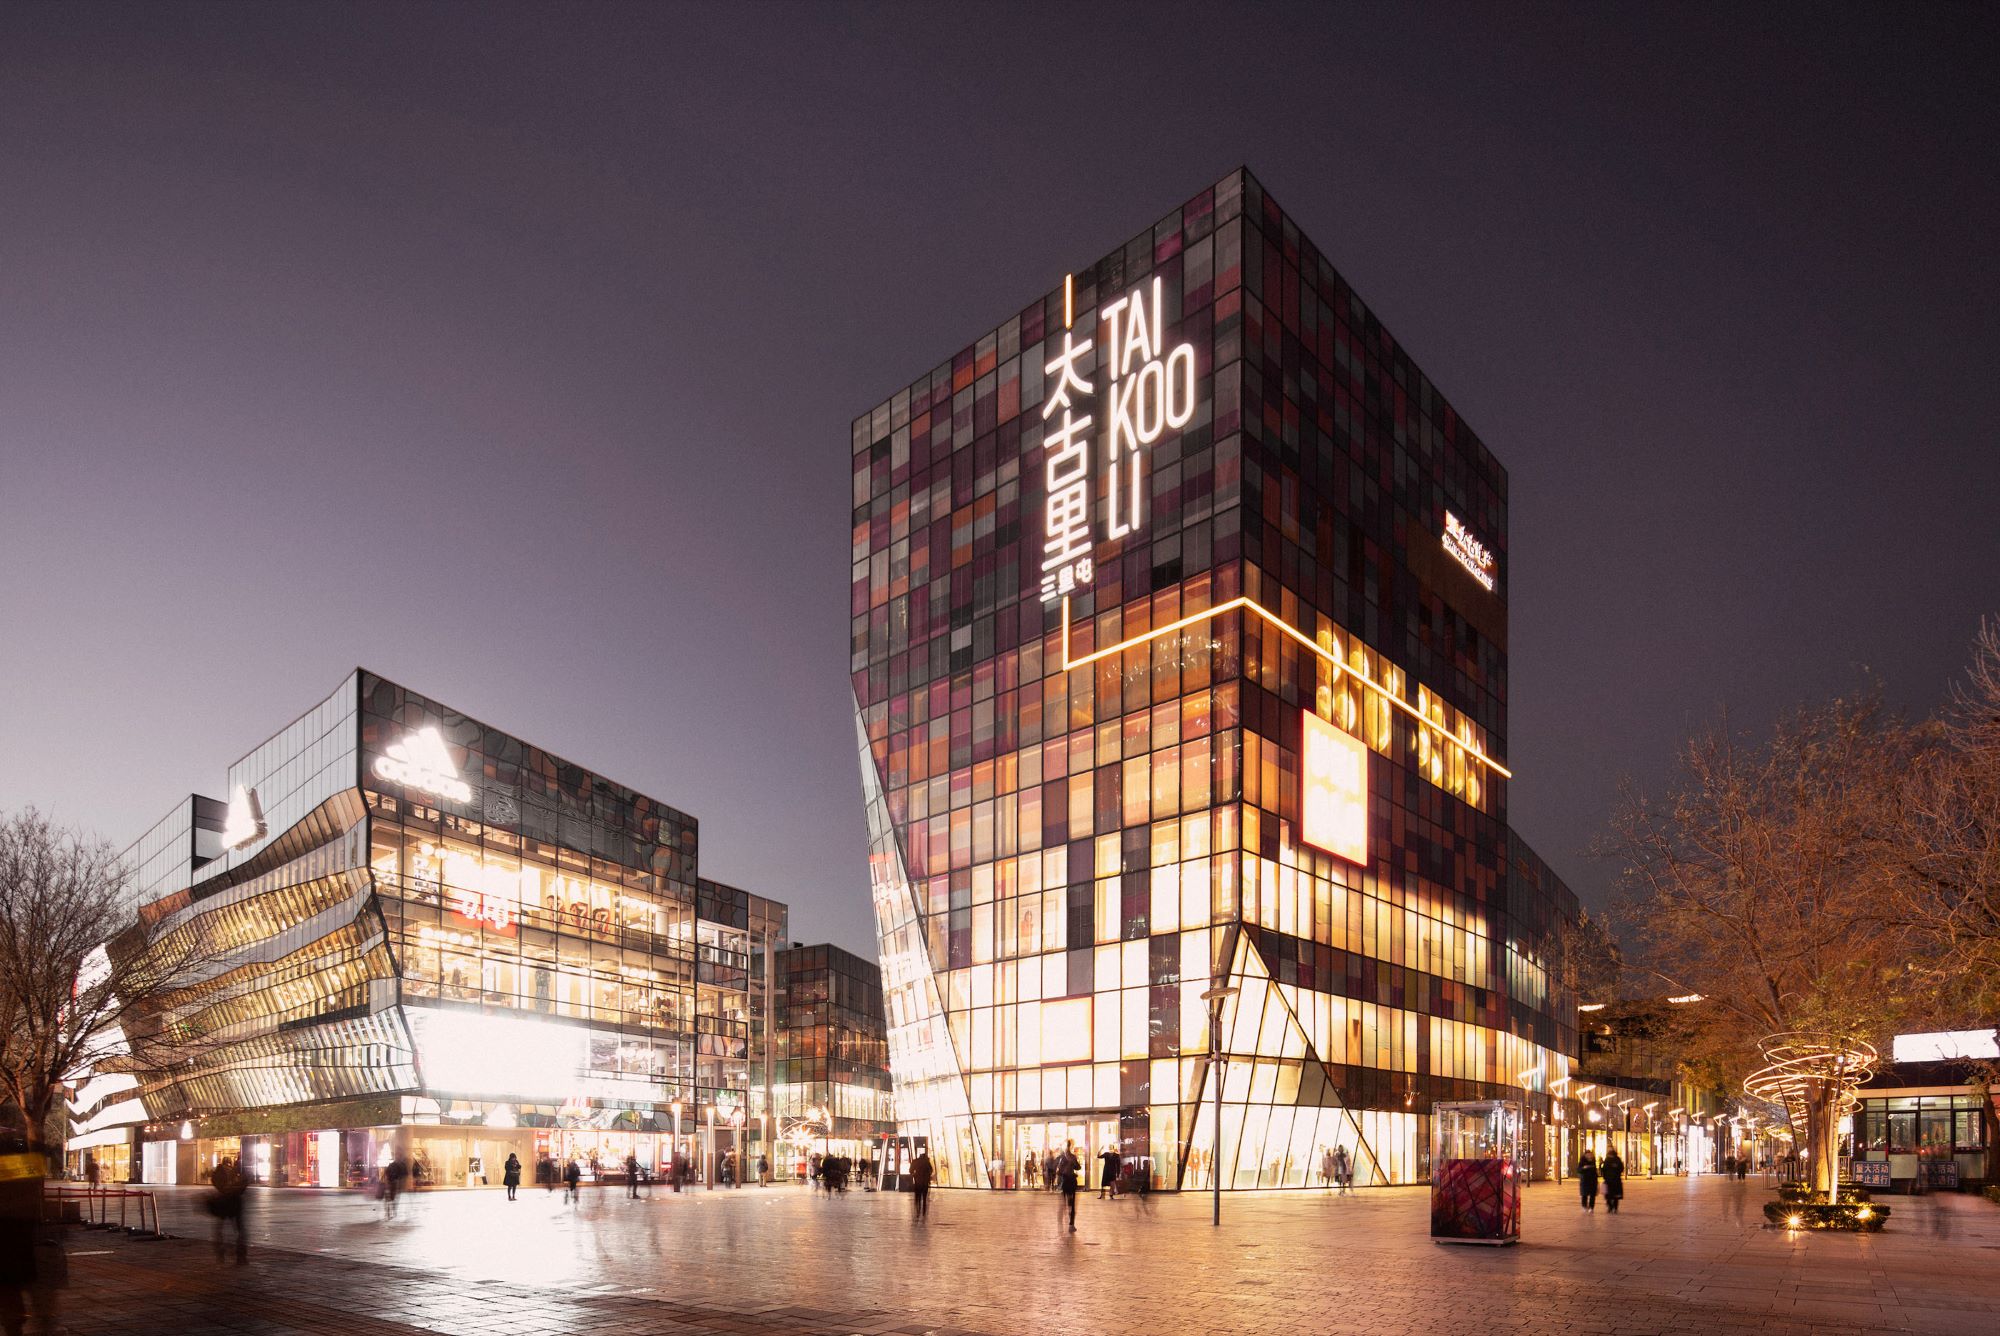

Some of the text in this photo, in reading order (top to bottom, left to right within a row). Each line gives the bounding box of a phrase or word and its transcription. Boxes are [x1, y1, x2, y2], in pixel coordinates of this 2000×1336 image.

[1101, 275, 1162, 382] TAI
[1040, 332, 1094, 572] 太古里
[1110, 342, 1195, 461] KOO
[1108, 450, 1141, 541] LI
